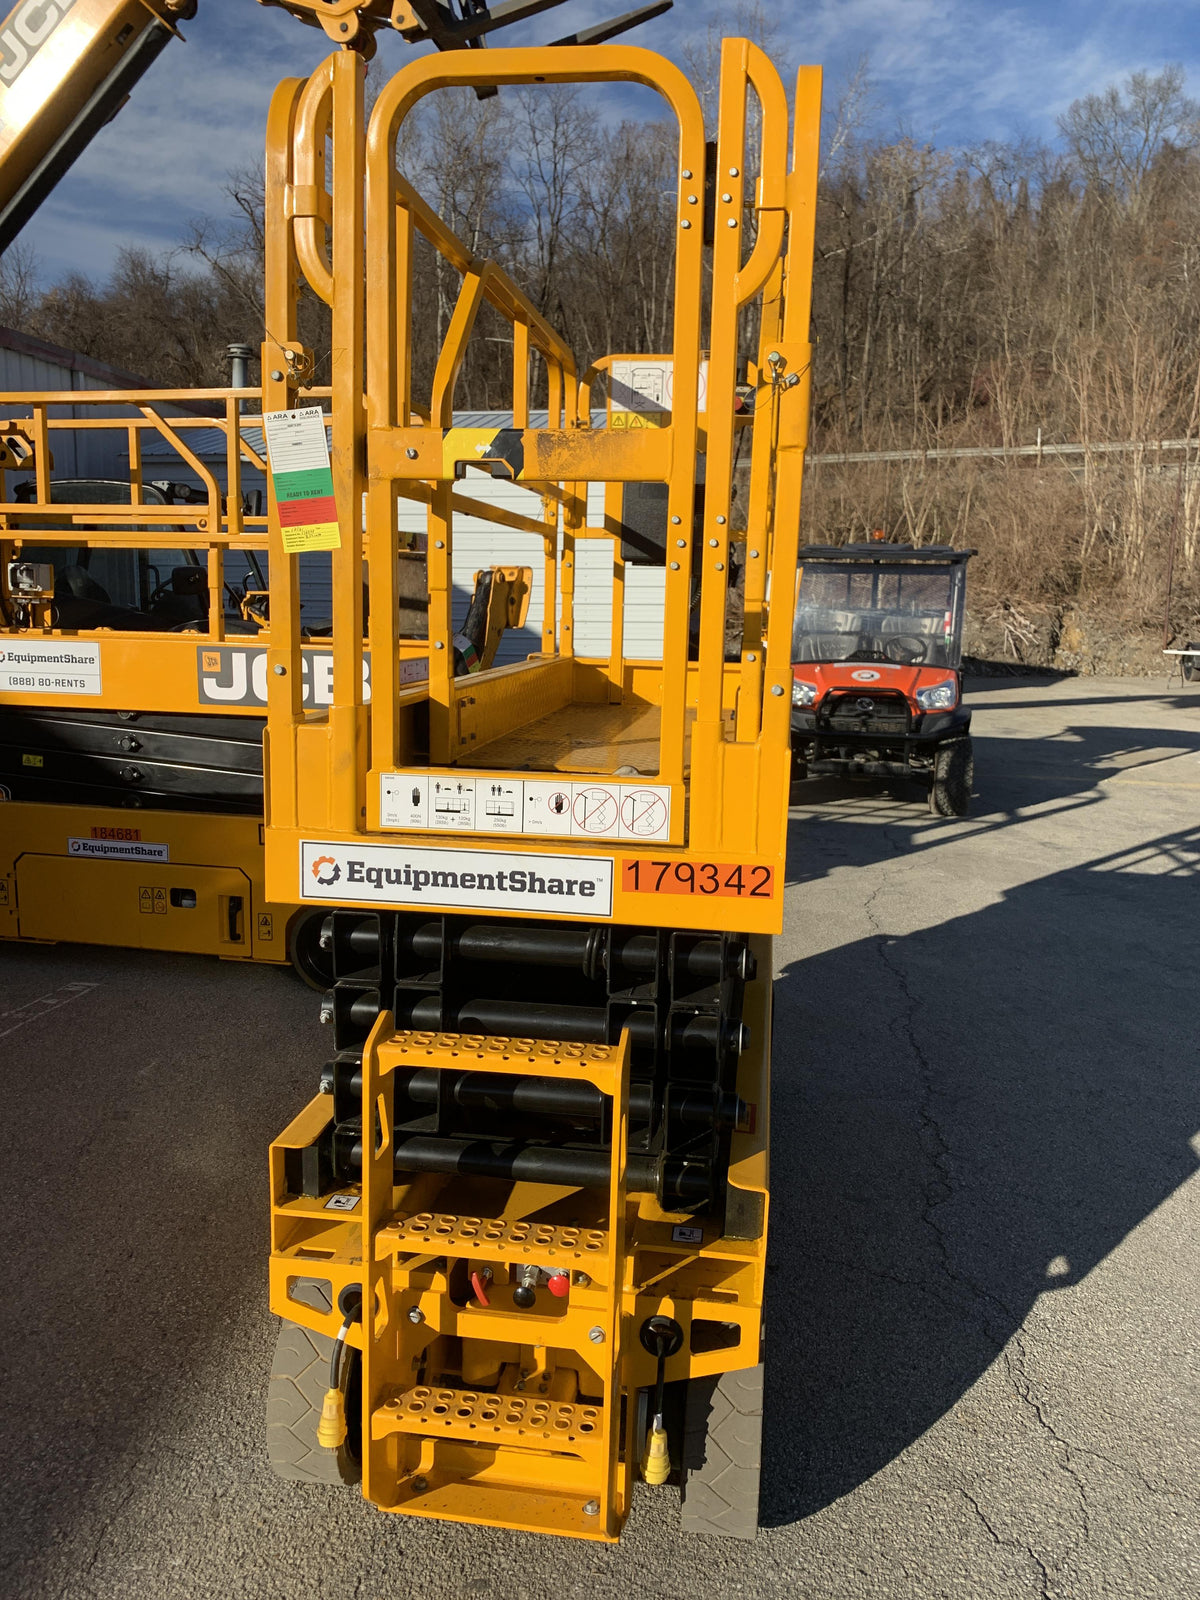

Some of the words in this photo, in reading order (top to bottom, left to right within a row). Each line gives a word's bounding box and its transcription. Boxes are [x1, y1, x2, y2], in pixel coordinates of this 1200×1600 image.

[0, 0, 72, 80] JC
[286, 491, 302, 499] READY
[311, 488, 323, 496] RENT
[7, 652, 95, 665] EquipmentShare
[9, 676, 35, 687] (888)
[38, 678, 86, 688] 80-RENTS
[93, 827, 139, 840] 184681
[82, 842, 164, 857] EquipmentShare
[627, 860, 771, 897] 179342
